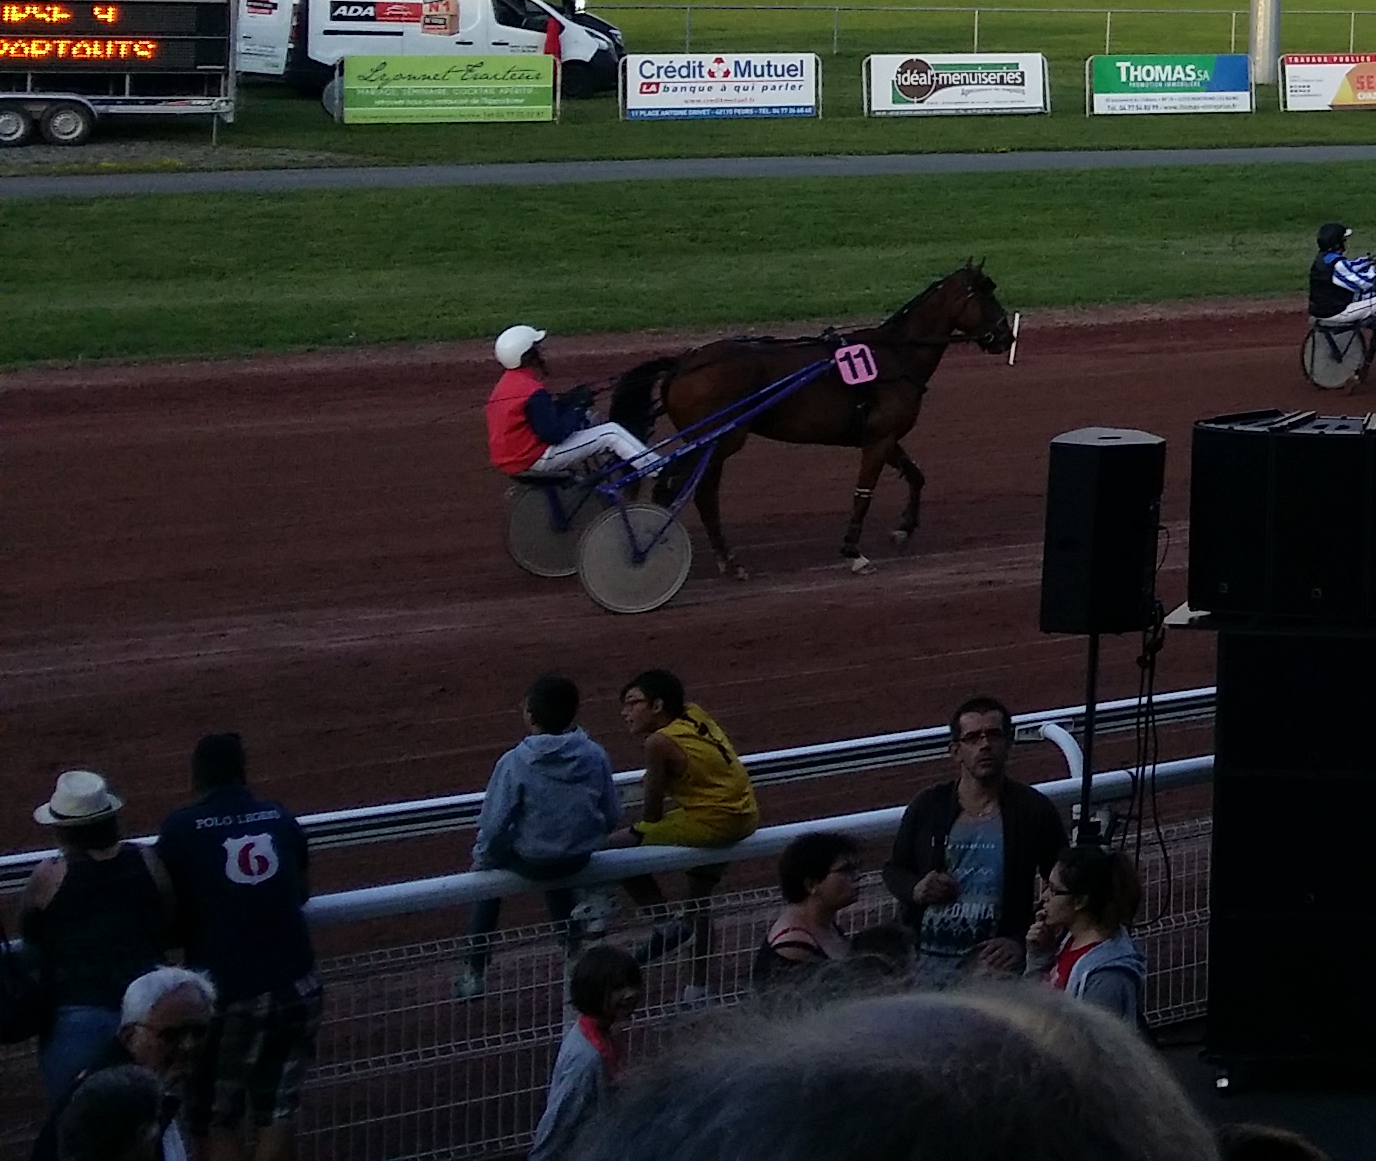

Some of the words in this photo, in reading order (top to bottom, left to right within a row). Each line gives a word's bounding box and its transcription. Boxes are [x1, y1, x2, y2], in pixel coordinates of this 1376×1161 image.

[93, 6, 117, 23] 4
[332, 4, 375, 17] ADA
[639, 59, 705, 80] Crédit
[733, 59, 804, 79] Mutuel
[897, 68, 932, 86] idéal
[938, 67, 1022, 85] menuiseries
[1115, 61, 1197, 82] THOMAS
[1197, 70, 1210, 81] SA
[641, 82, 659, 94] LA
[662, 83, 714, 94] banque
[720, 82, 727, 92] à
[733, 83, 755, 94] qui
[761, 82, 804, 94] parler
[839, 347, 874, 380] 11
[195, 815, 233, 830] POLO
[237, 842, 269, 876] 6
